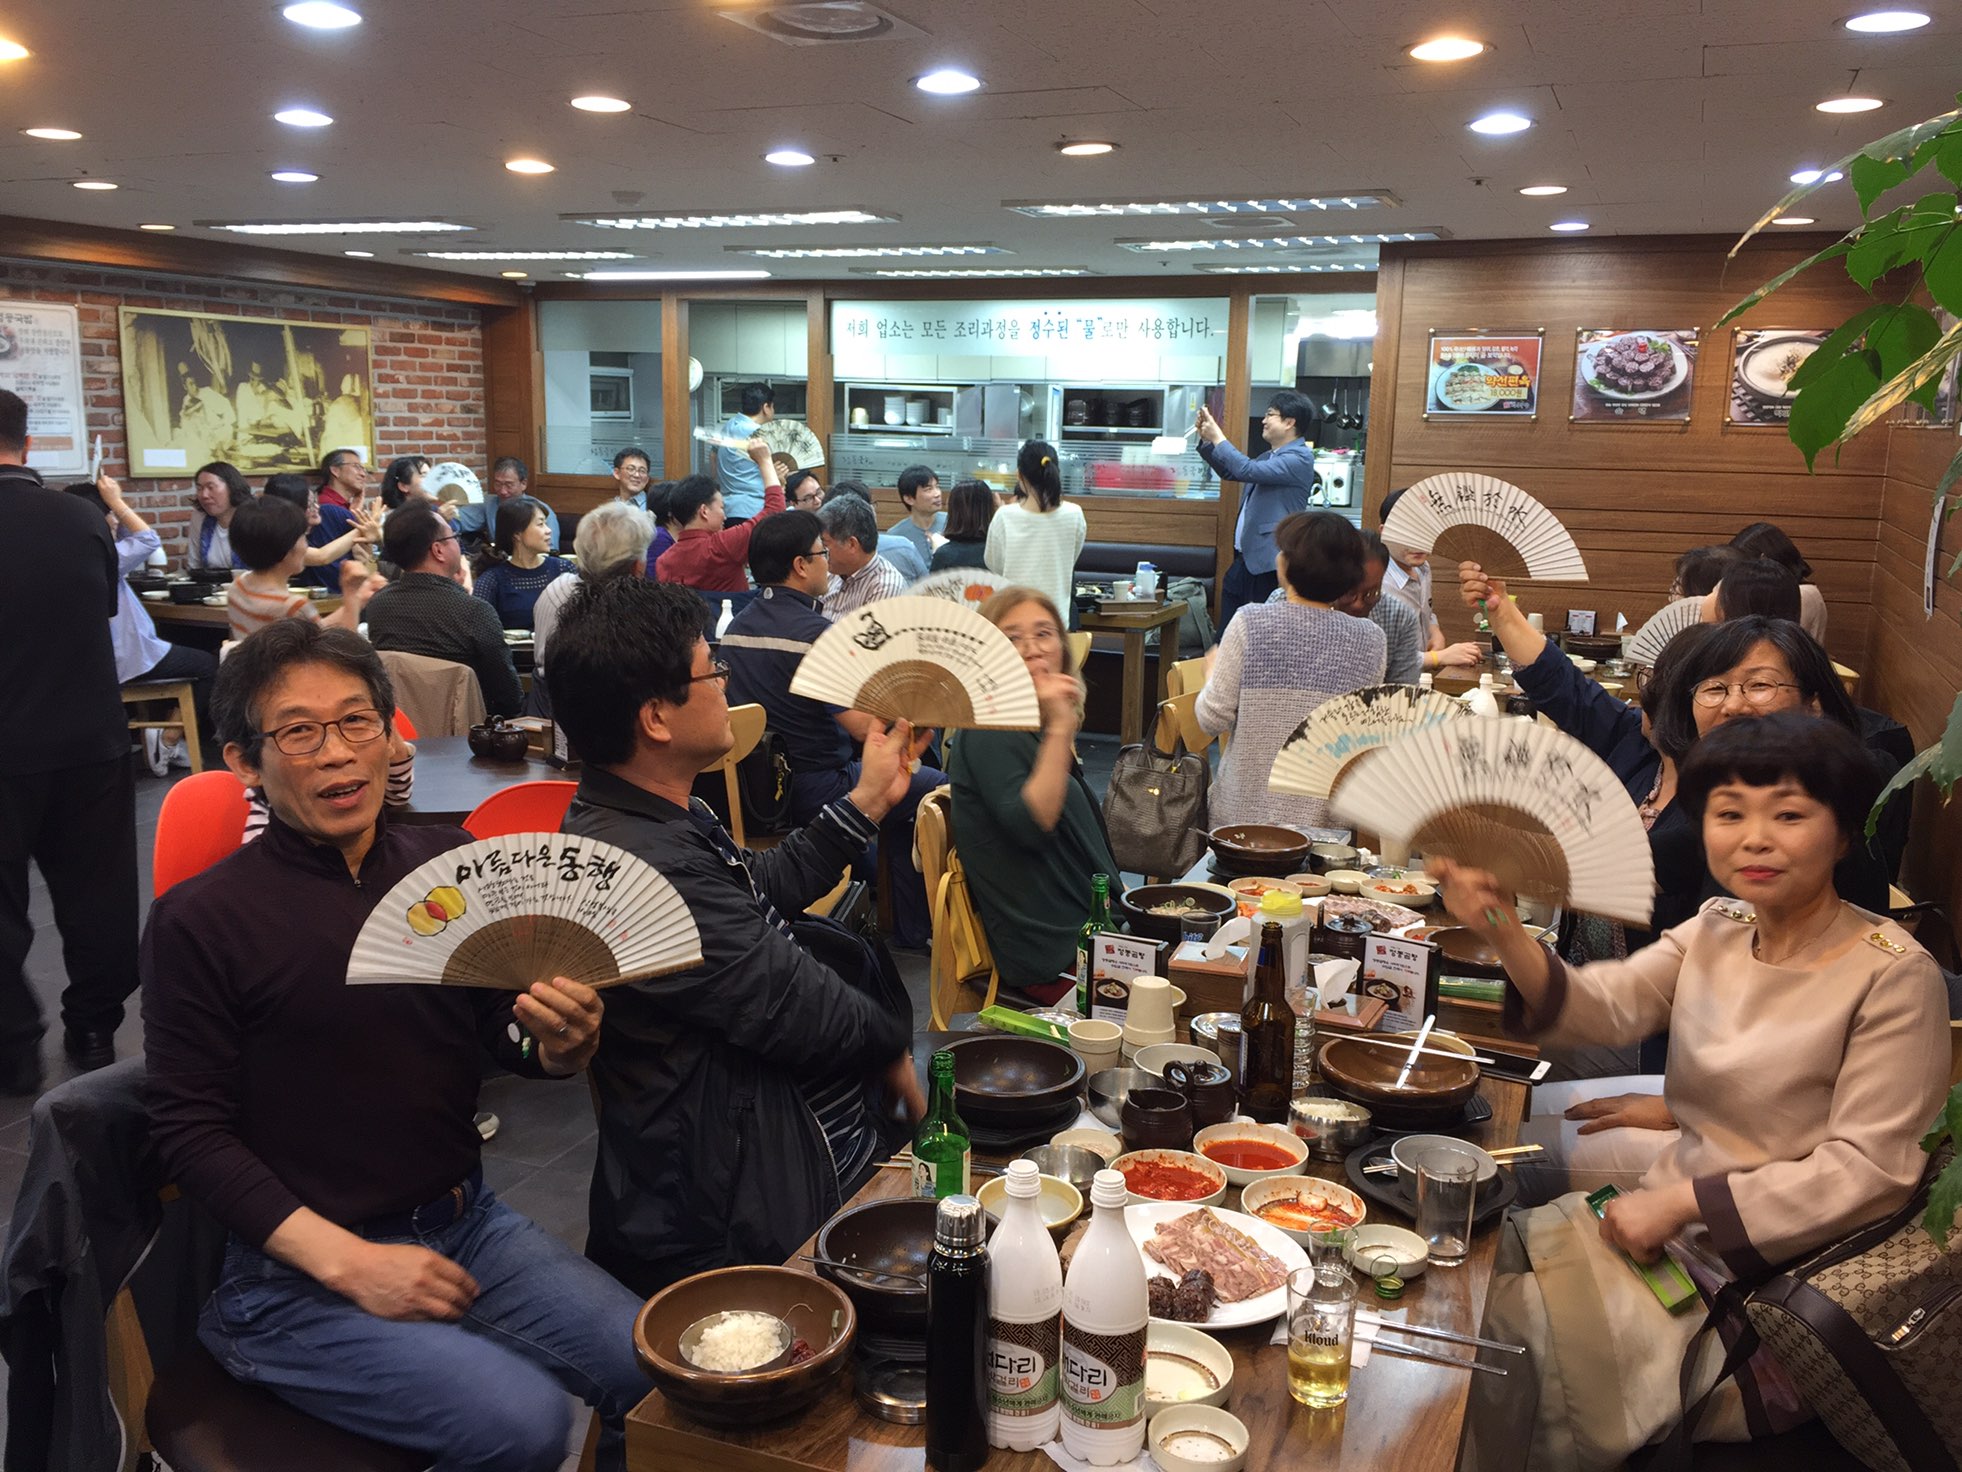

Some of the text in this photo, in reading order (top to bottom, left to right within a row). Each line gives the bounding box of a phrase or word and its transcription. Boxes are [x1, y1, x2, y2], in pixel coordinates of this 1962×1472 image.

[876, 318, 915, 339] 업소는
[921, 319, 947, 339] 모든
[953, 318, 1021, 340] 조리과정을
[1030, 317, 1069, 340] 정수된
[1138, 316, 1215, 340] 사용합니다.
[455, 844, 622, 892] 아름다운 동행
